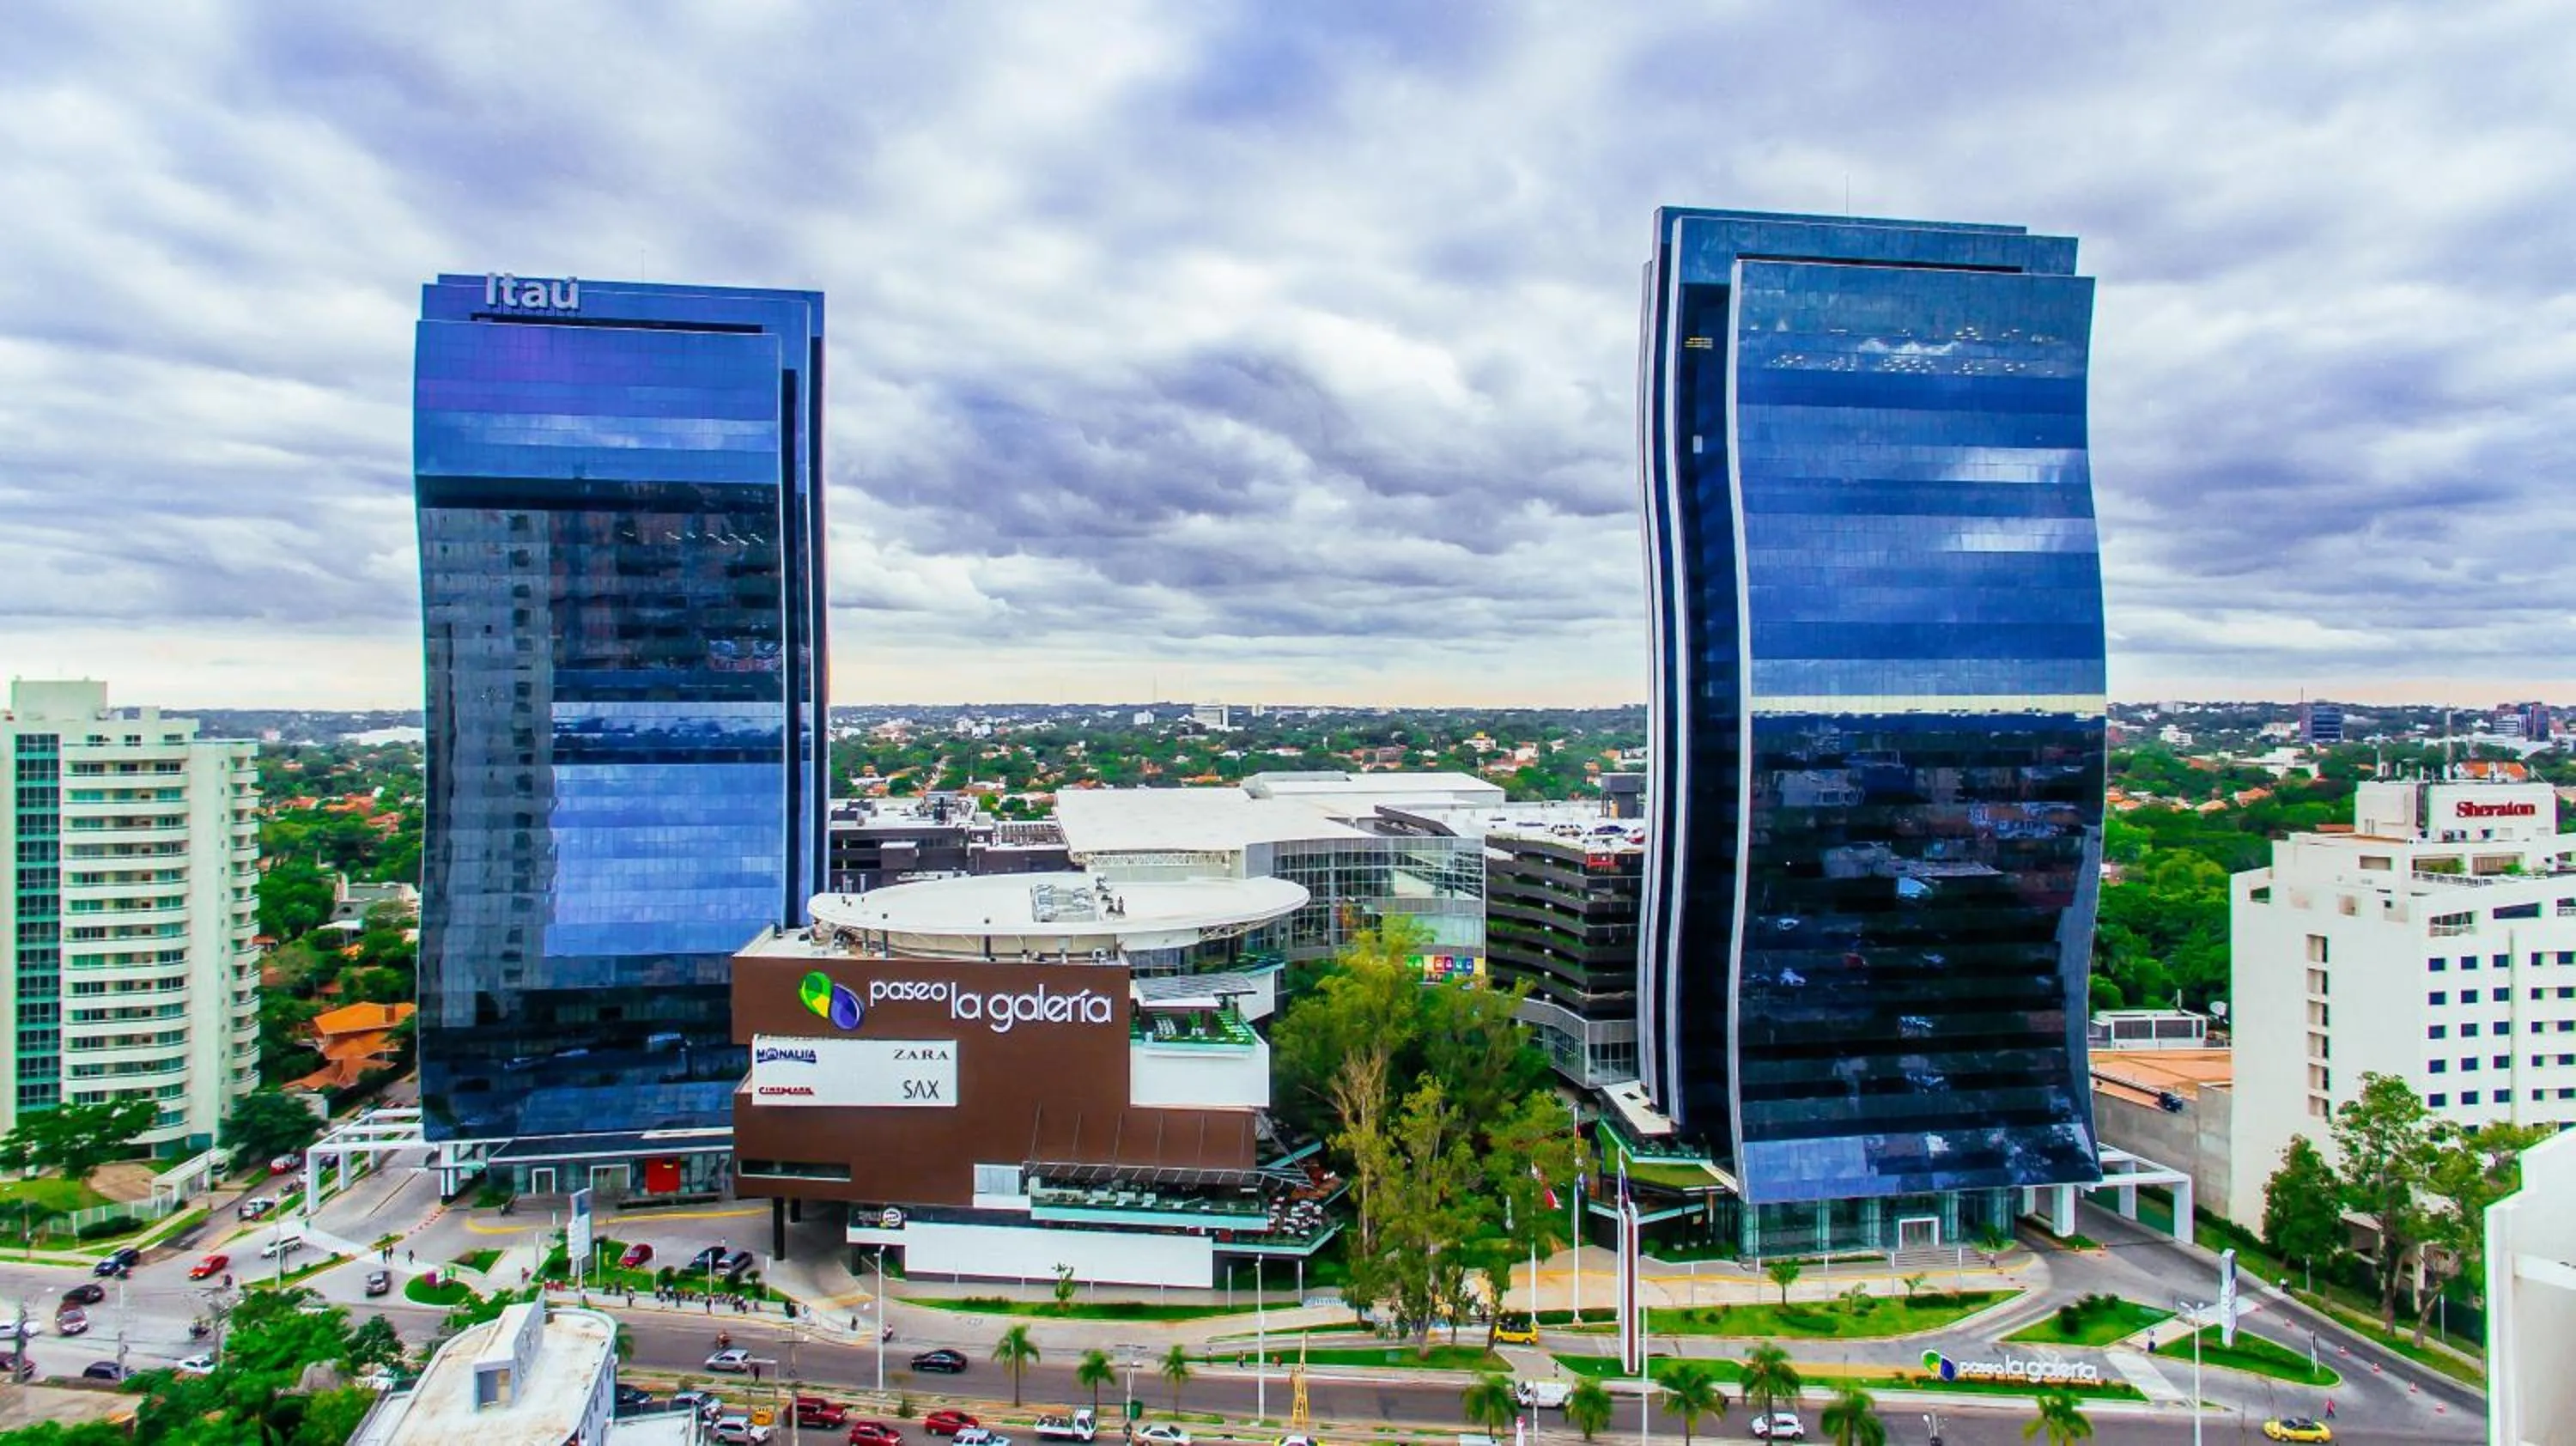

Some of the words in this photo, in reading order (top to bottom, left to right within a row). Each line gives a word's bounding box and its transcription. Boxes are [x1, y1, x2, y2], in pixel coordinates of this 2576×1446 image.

[485, 272, 580, 309] Itaú
[2456, 801, 2536, 817] Sheraton
[869, 981, 946, 1007] paseo
[951, 981, 981, 1019] la
[987, 983, 1113, 1033] galería
[893, 1049, 949, 1060] ZARA
[903, 1079, 939, 1100] SAX
